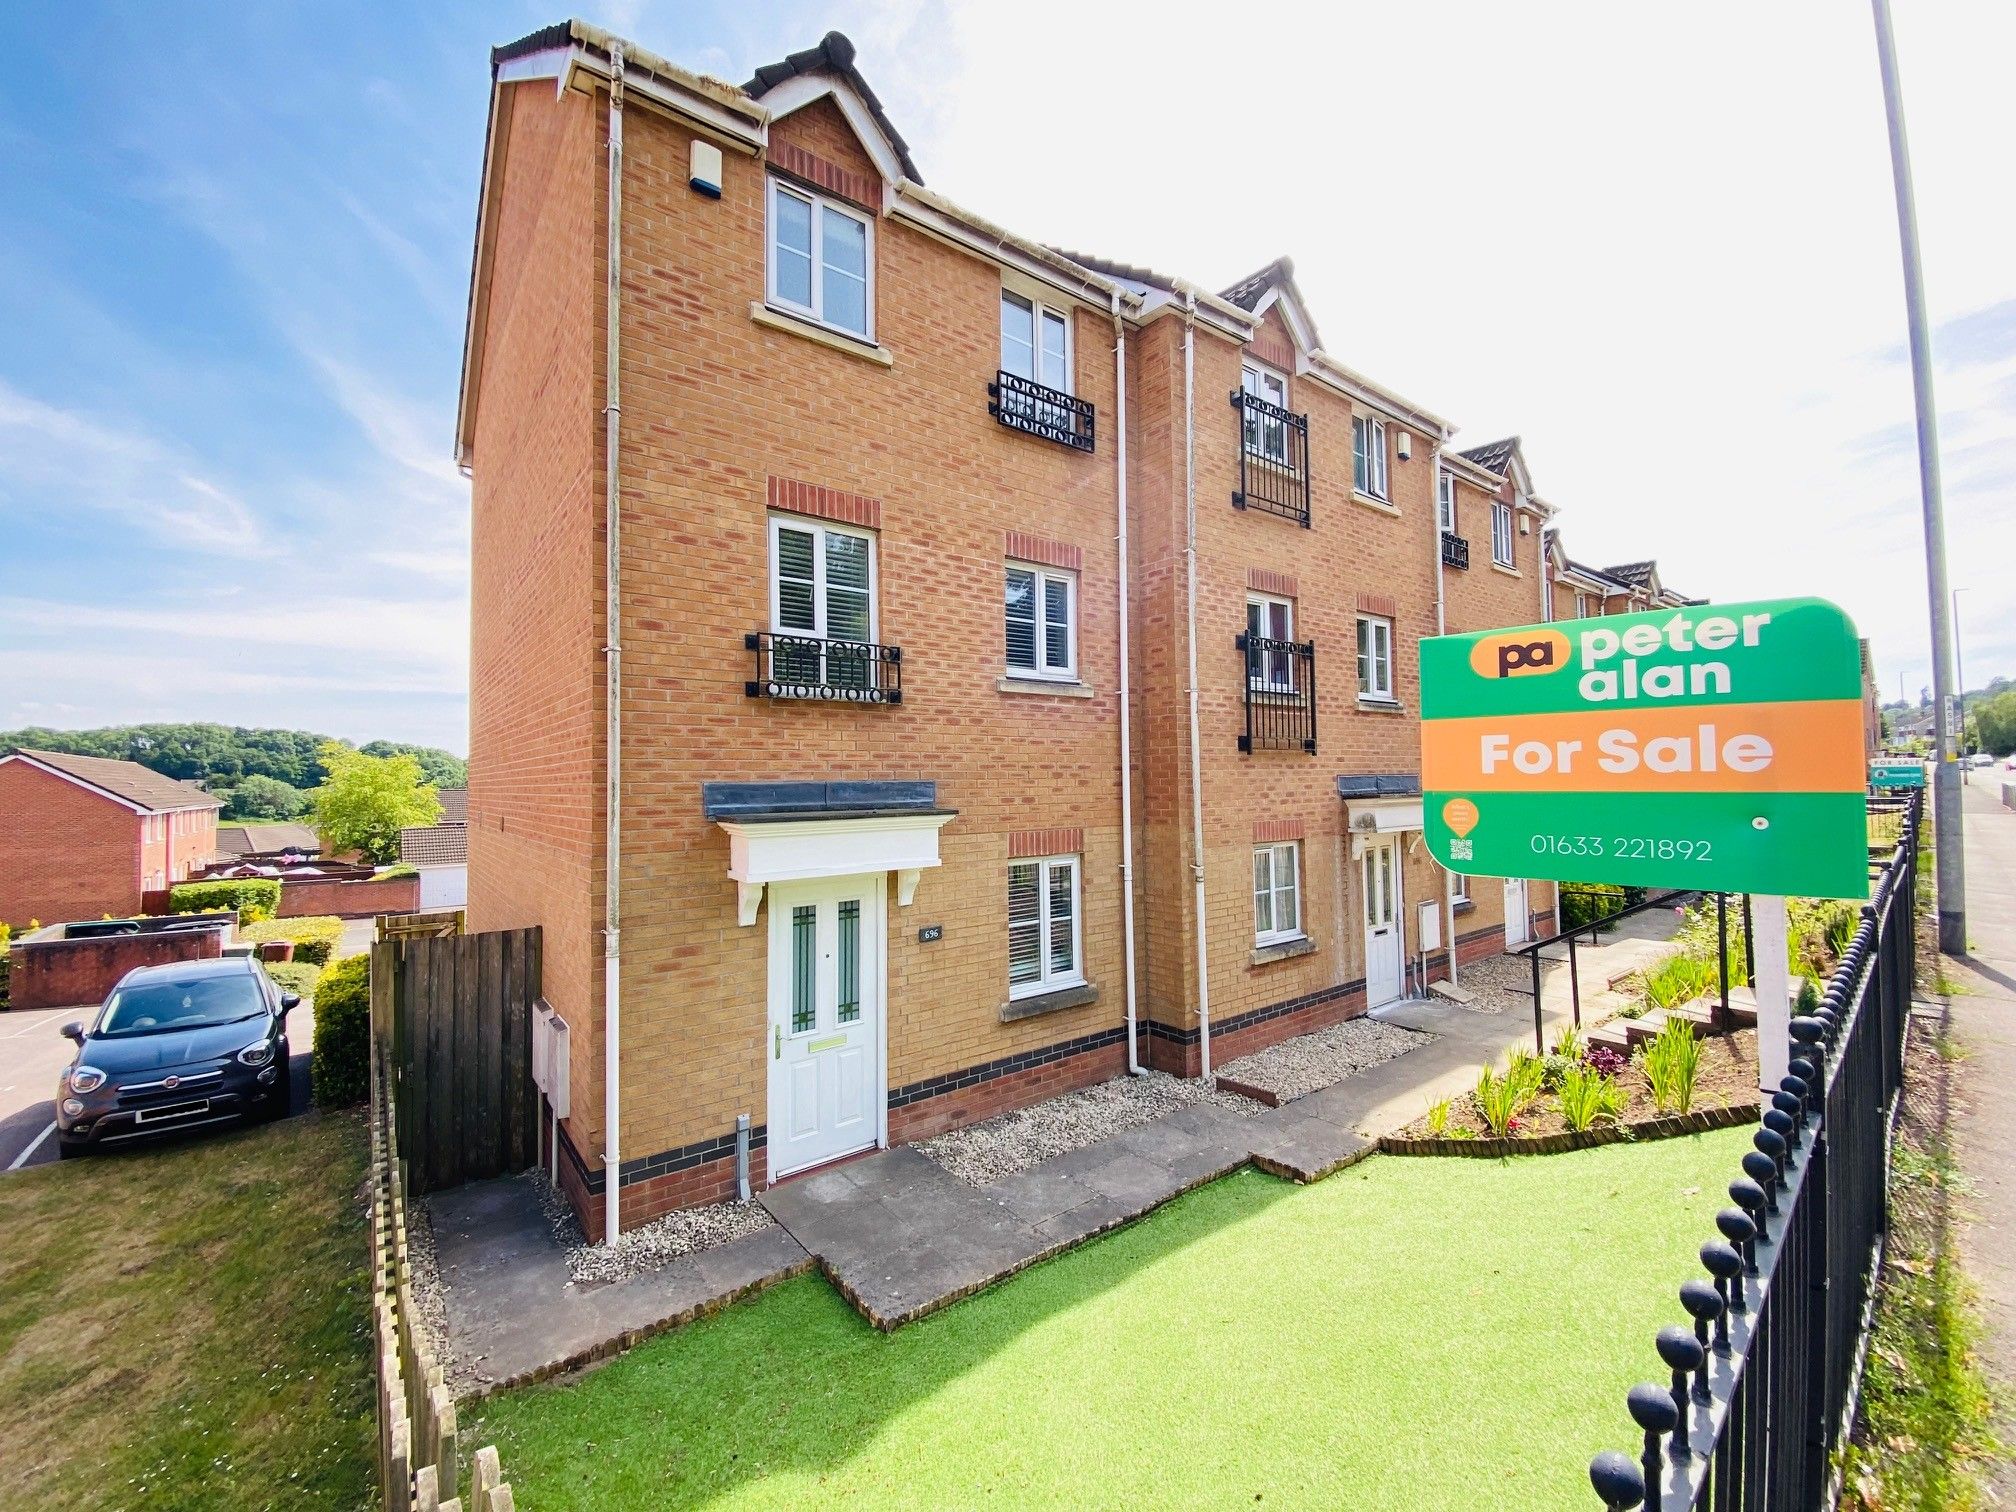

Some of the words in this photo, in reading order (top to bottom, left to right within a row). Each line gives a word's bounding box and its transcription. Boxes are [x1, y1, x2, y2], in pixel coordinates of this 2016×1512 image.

[1498, 640, 1553, 678] pa
[1580, 613, 1771, 670] peter
[1578, 658, 1731, 702] alan
[1480, 734, 1582, 774] For
[1598, 724, 1773, 774] Sale
[1531, 834, 1604, 856] 01633
[1613, 837, 1713, 862] 221892
[924, 929, 939, 939] 696
